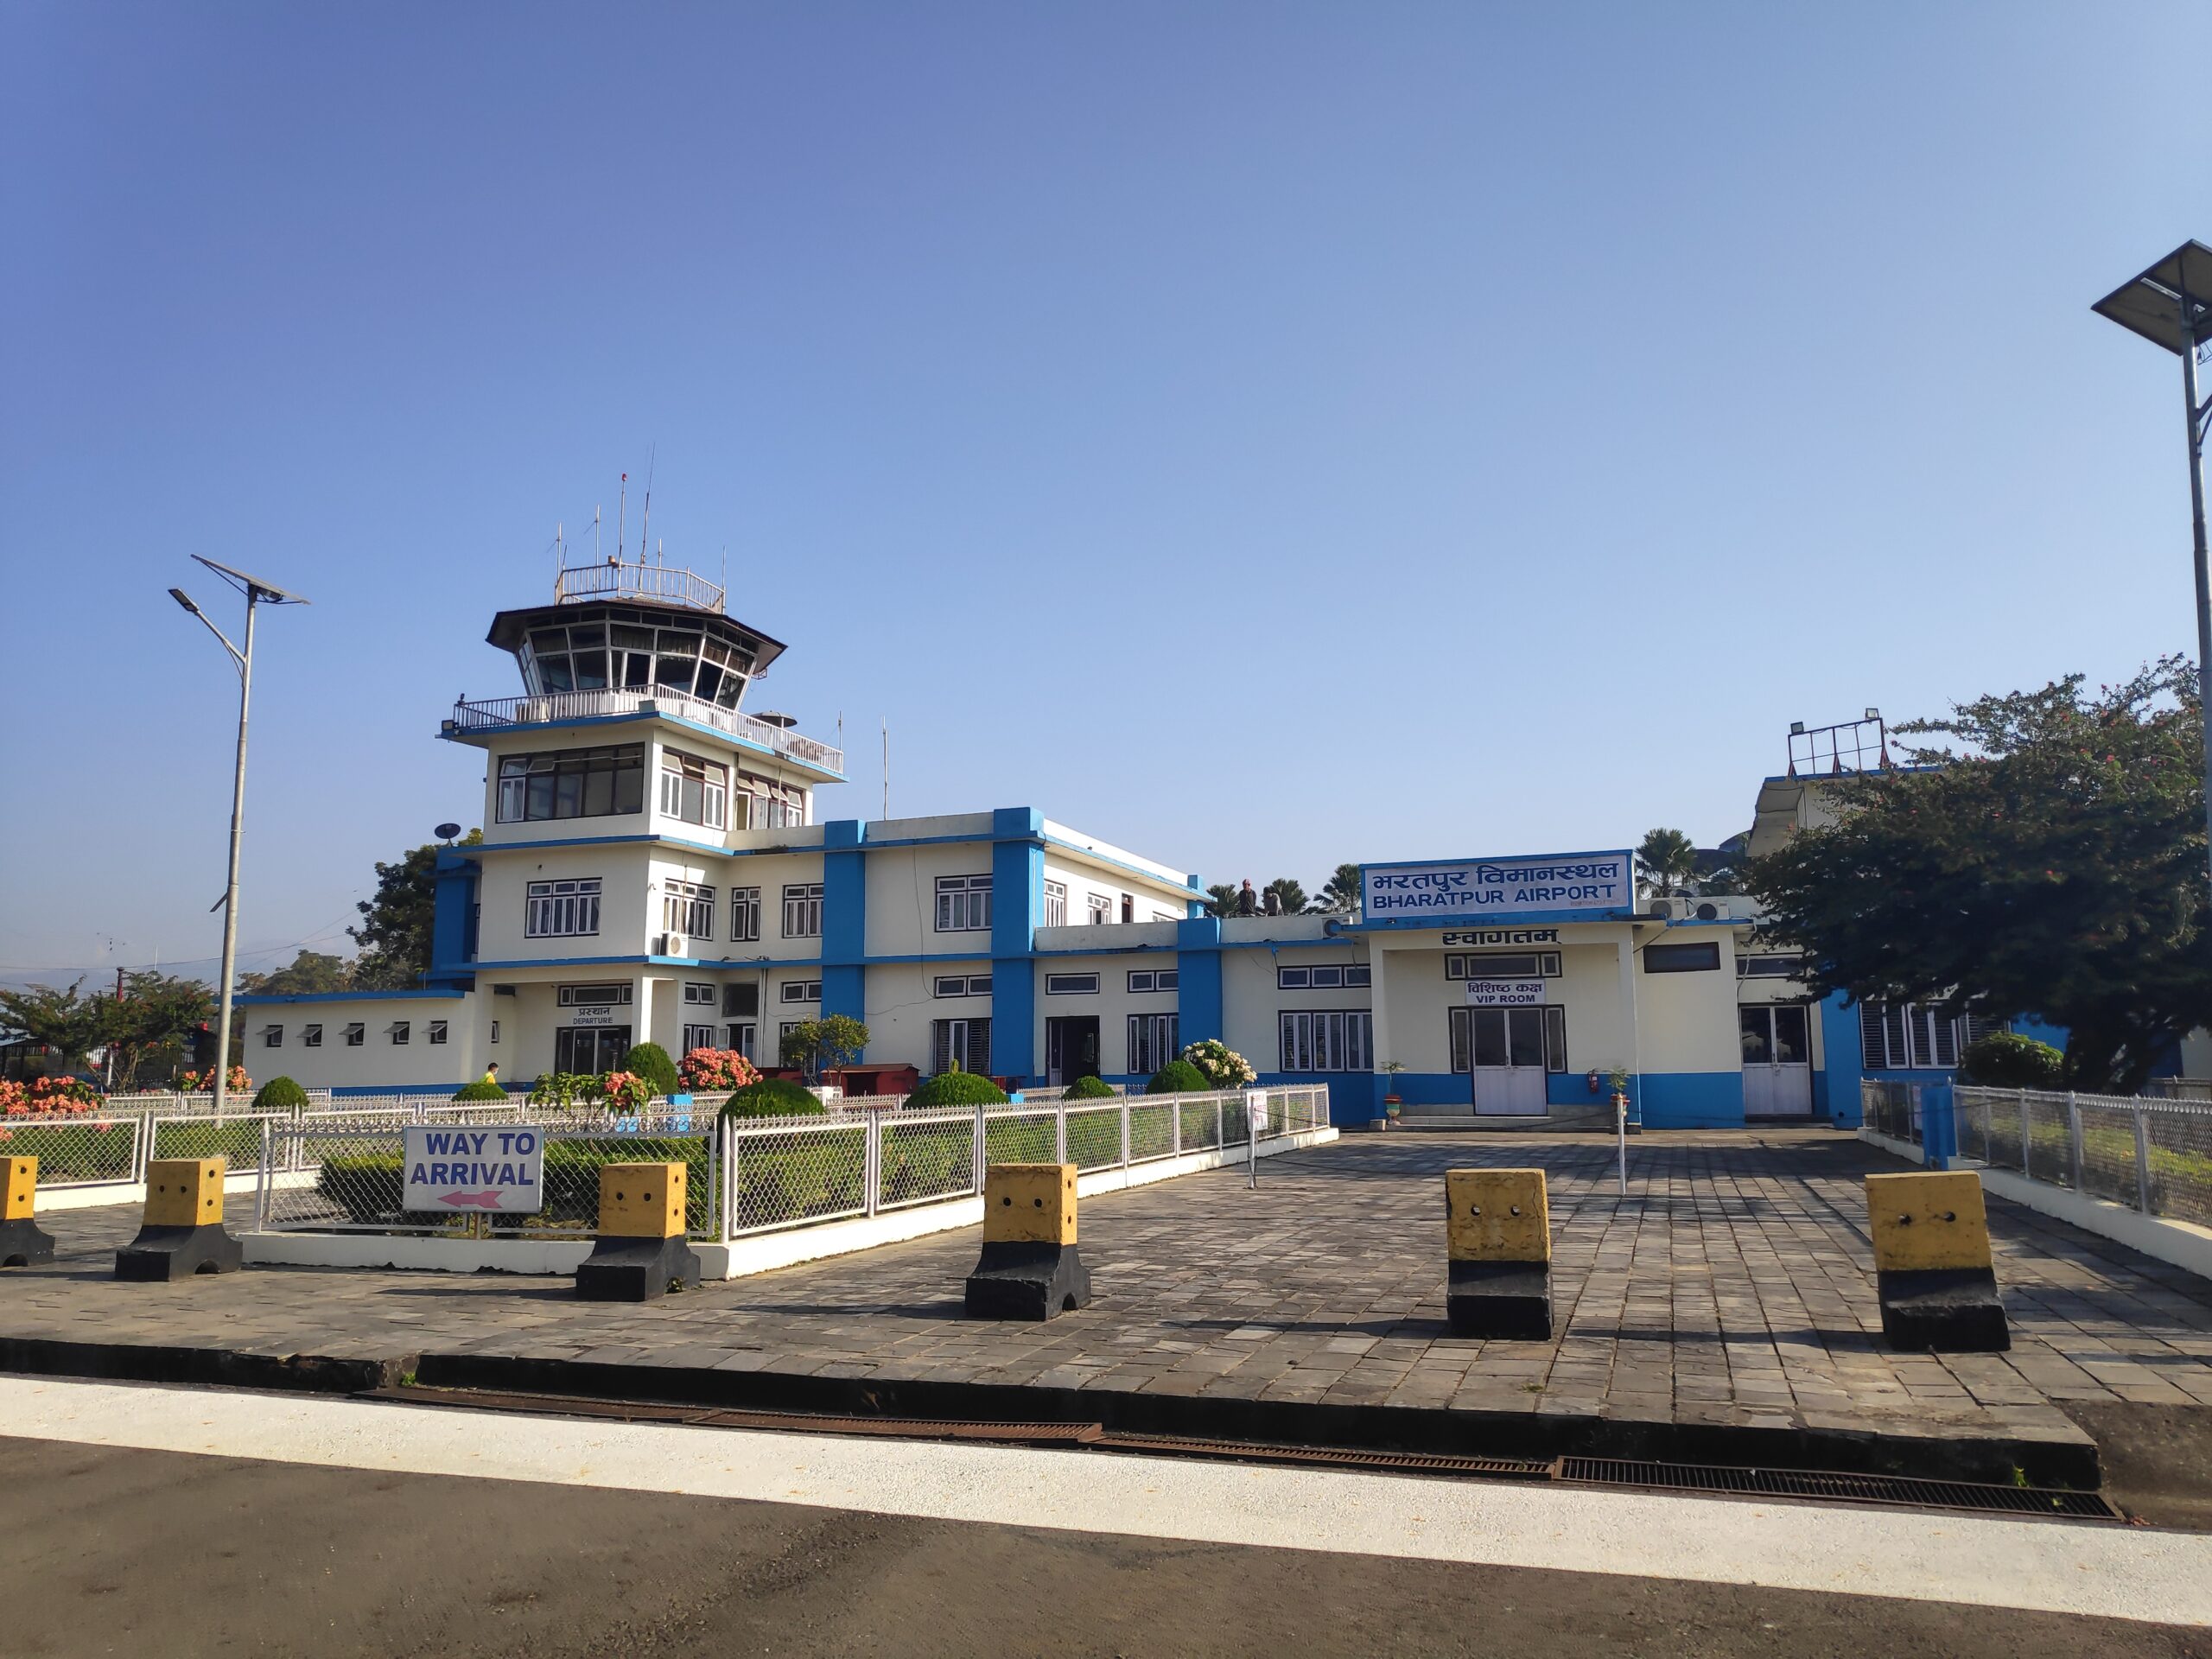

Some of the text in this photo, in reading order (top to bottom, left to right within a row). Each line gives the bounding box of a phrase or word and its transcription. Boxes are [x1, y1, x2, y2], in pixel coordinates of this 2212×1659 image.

[1372, 863, 1619, 893] भरतपुर विमानस्थल
[1373, 890, 1505, 909] BHARATPUR
[1514, 884, 1617, 903] AIRPORT
[1442, 929, 1562, 945] स्वागतम्
[1499, 995, 1535, 1003] ROOM
[1516, 983, 1543, 993] कक्ष
[426, 1132, 536, 1155] WAY TO
[410, 1163, 534, 1185] ARRIVAL
